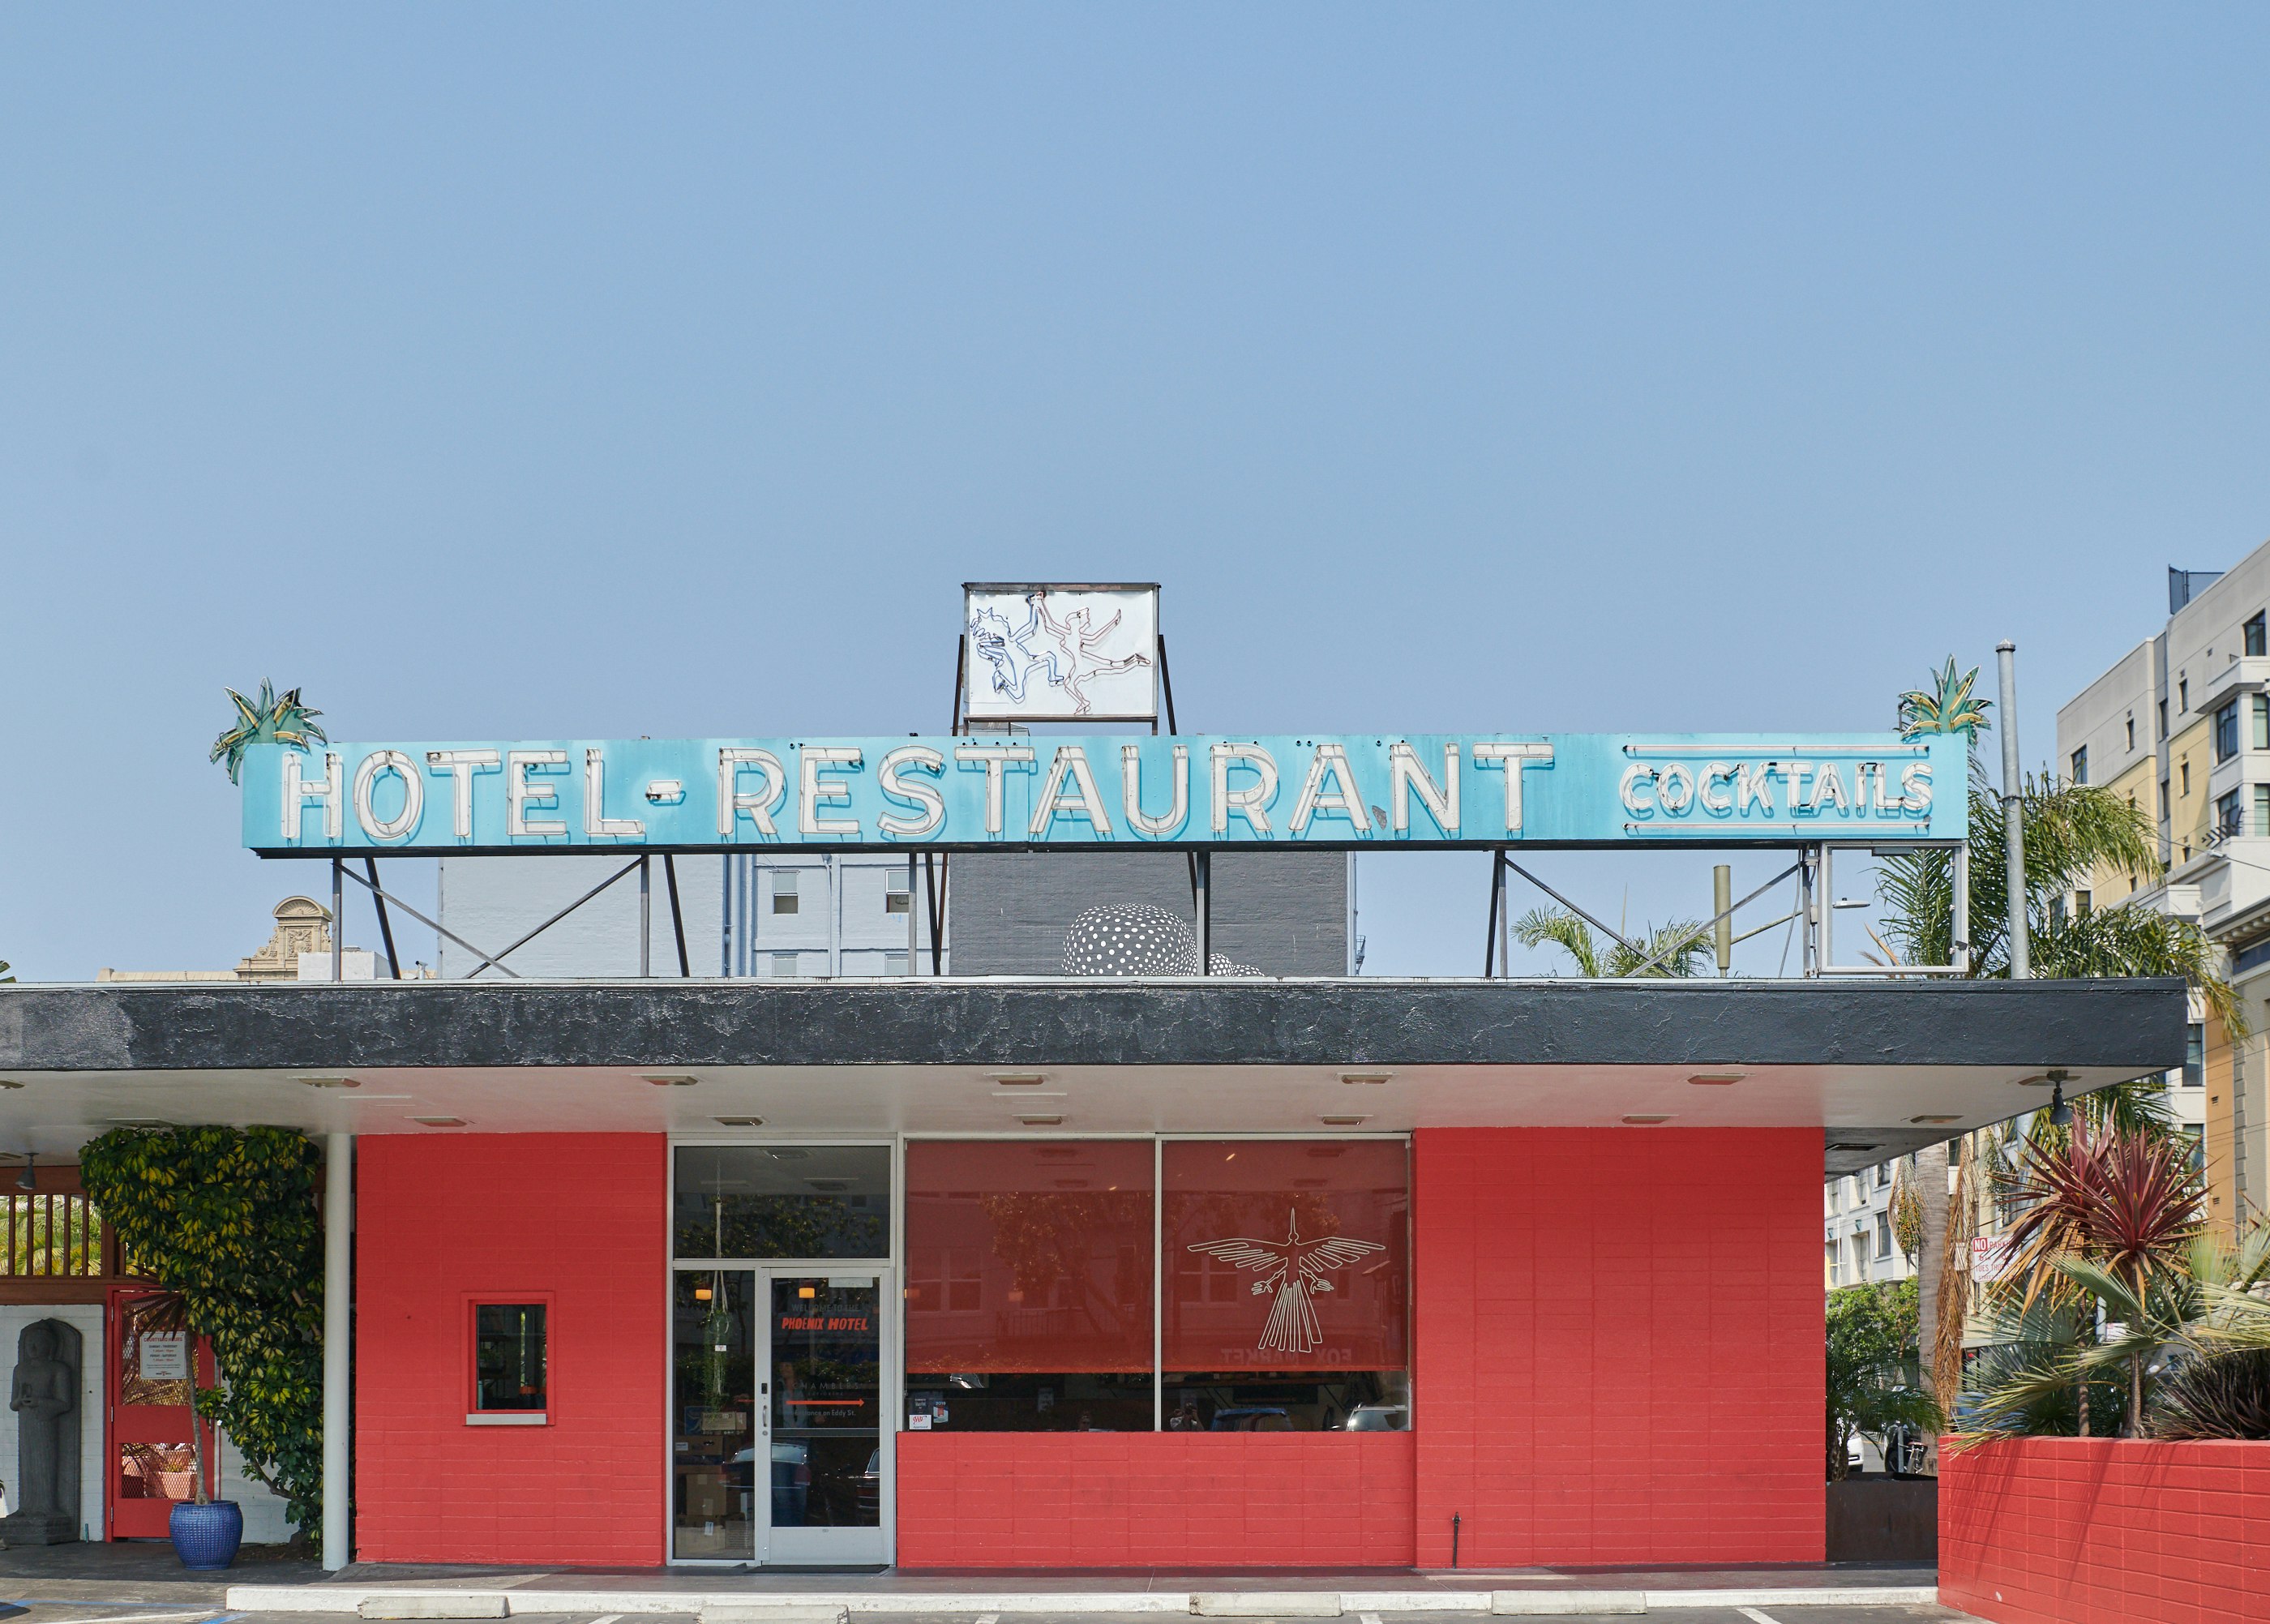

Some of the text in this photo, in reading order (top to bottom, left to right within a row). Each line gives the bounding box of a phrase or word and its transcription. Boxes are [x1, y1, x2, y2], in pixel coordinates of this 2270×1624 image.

[717, 743, 1554, 835] RESTAURANT
[1619, 761, 1934, 812] COCKTAILS
[1974, 1239, 1987, 1251] NO
[791, 1304, 833, 1312] WELCOME
[782, 1318, 868, 1330] PHOENIX HOTEL
[832, 1409, 846, 1417] Eddy
